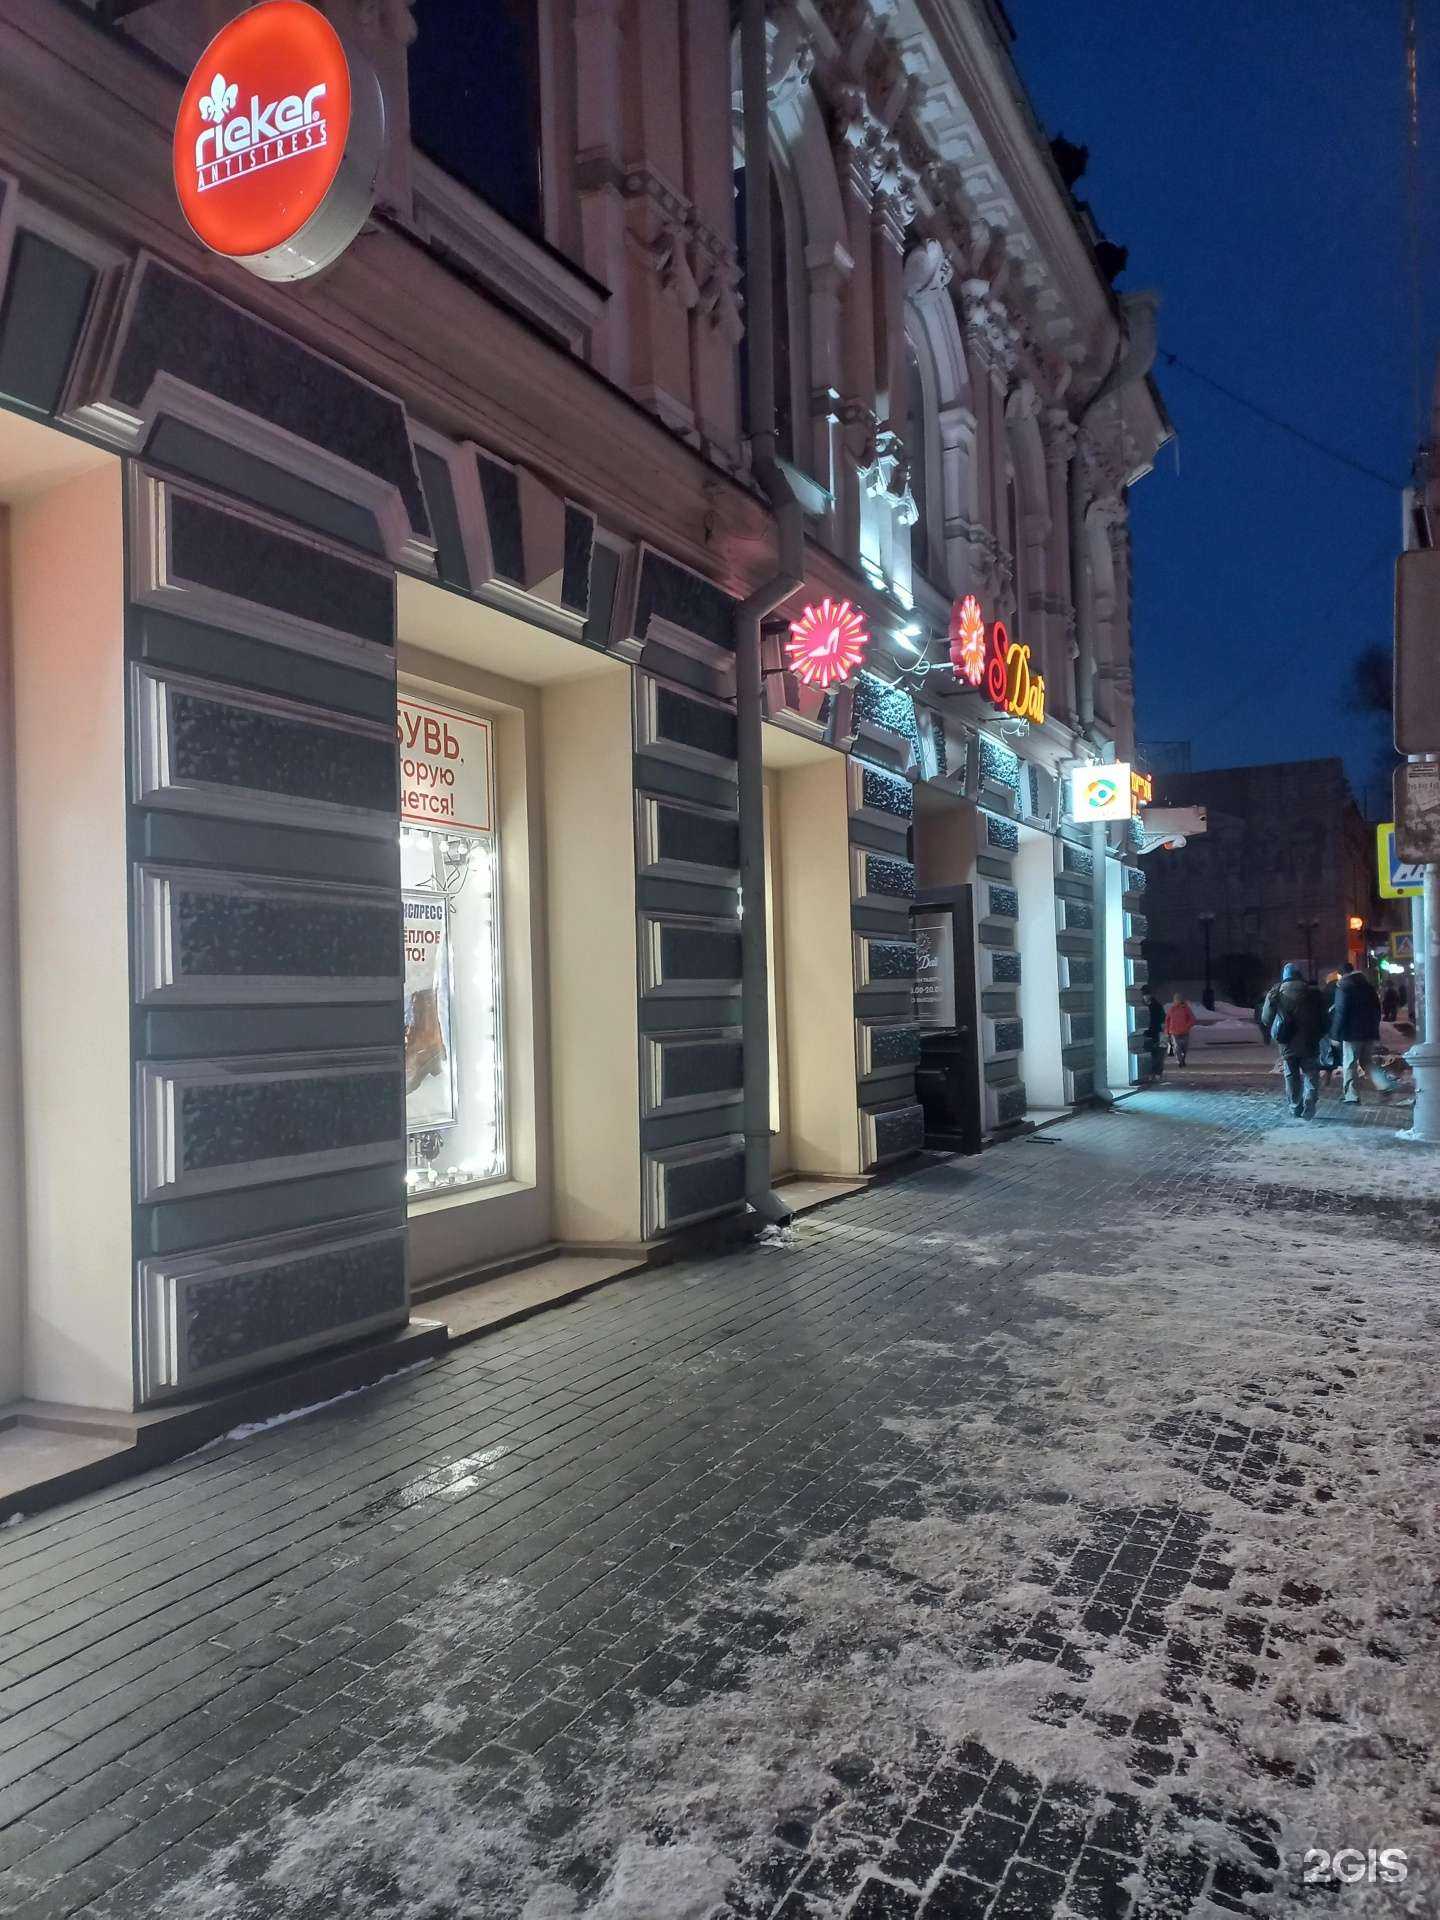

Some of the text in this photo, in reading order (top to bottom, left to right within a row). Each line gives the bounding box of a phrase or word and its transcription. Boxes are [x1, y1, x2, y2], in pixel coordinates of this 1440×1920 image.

[196, 83, 327, 167] rieker
[198, 123, 328, 190] ANTISTRESS
[401, 758, 455, 788] орую
